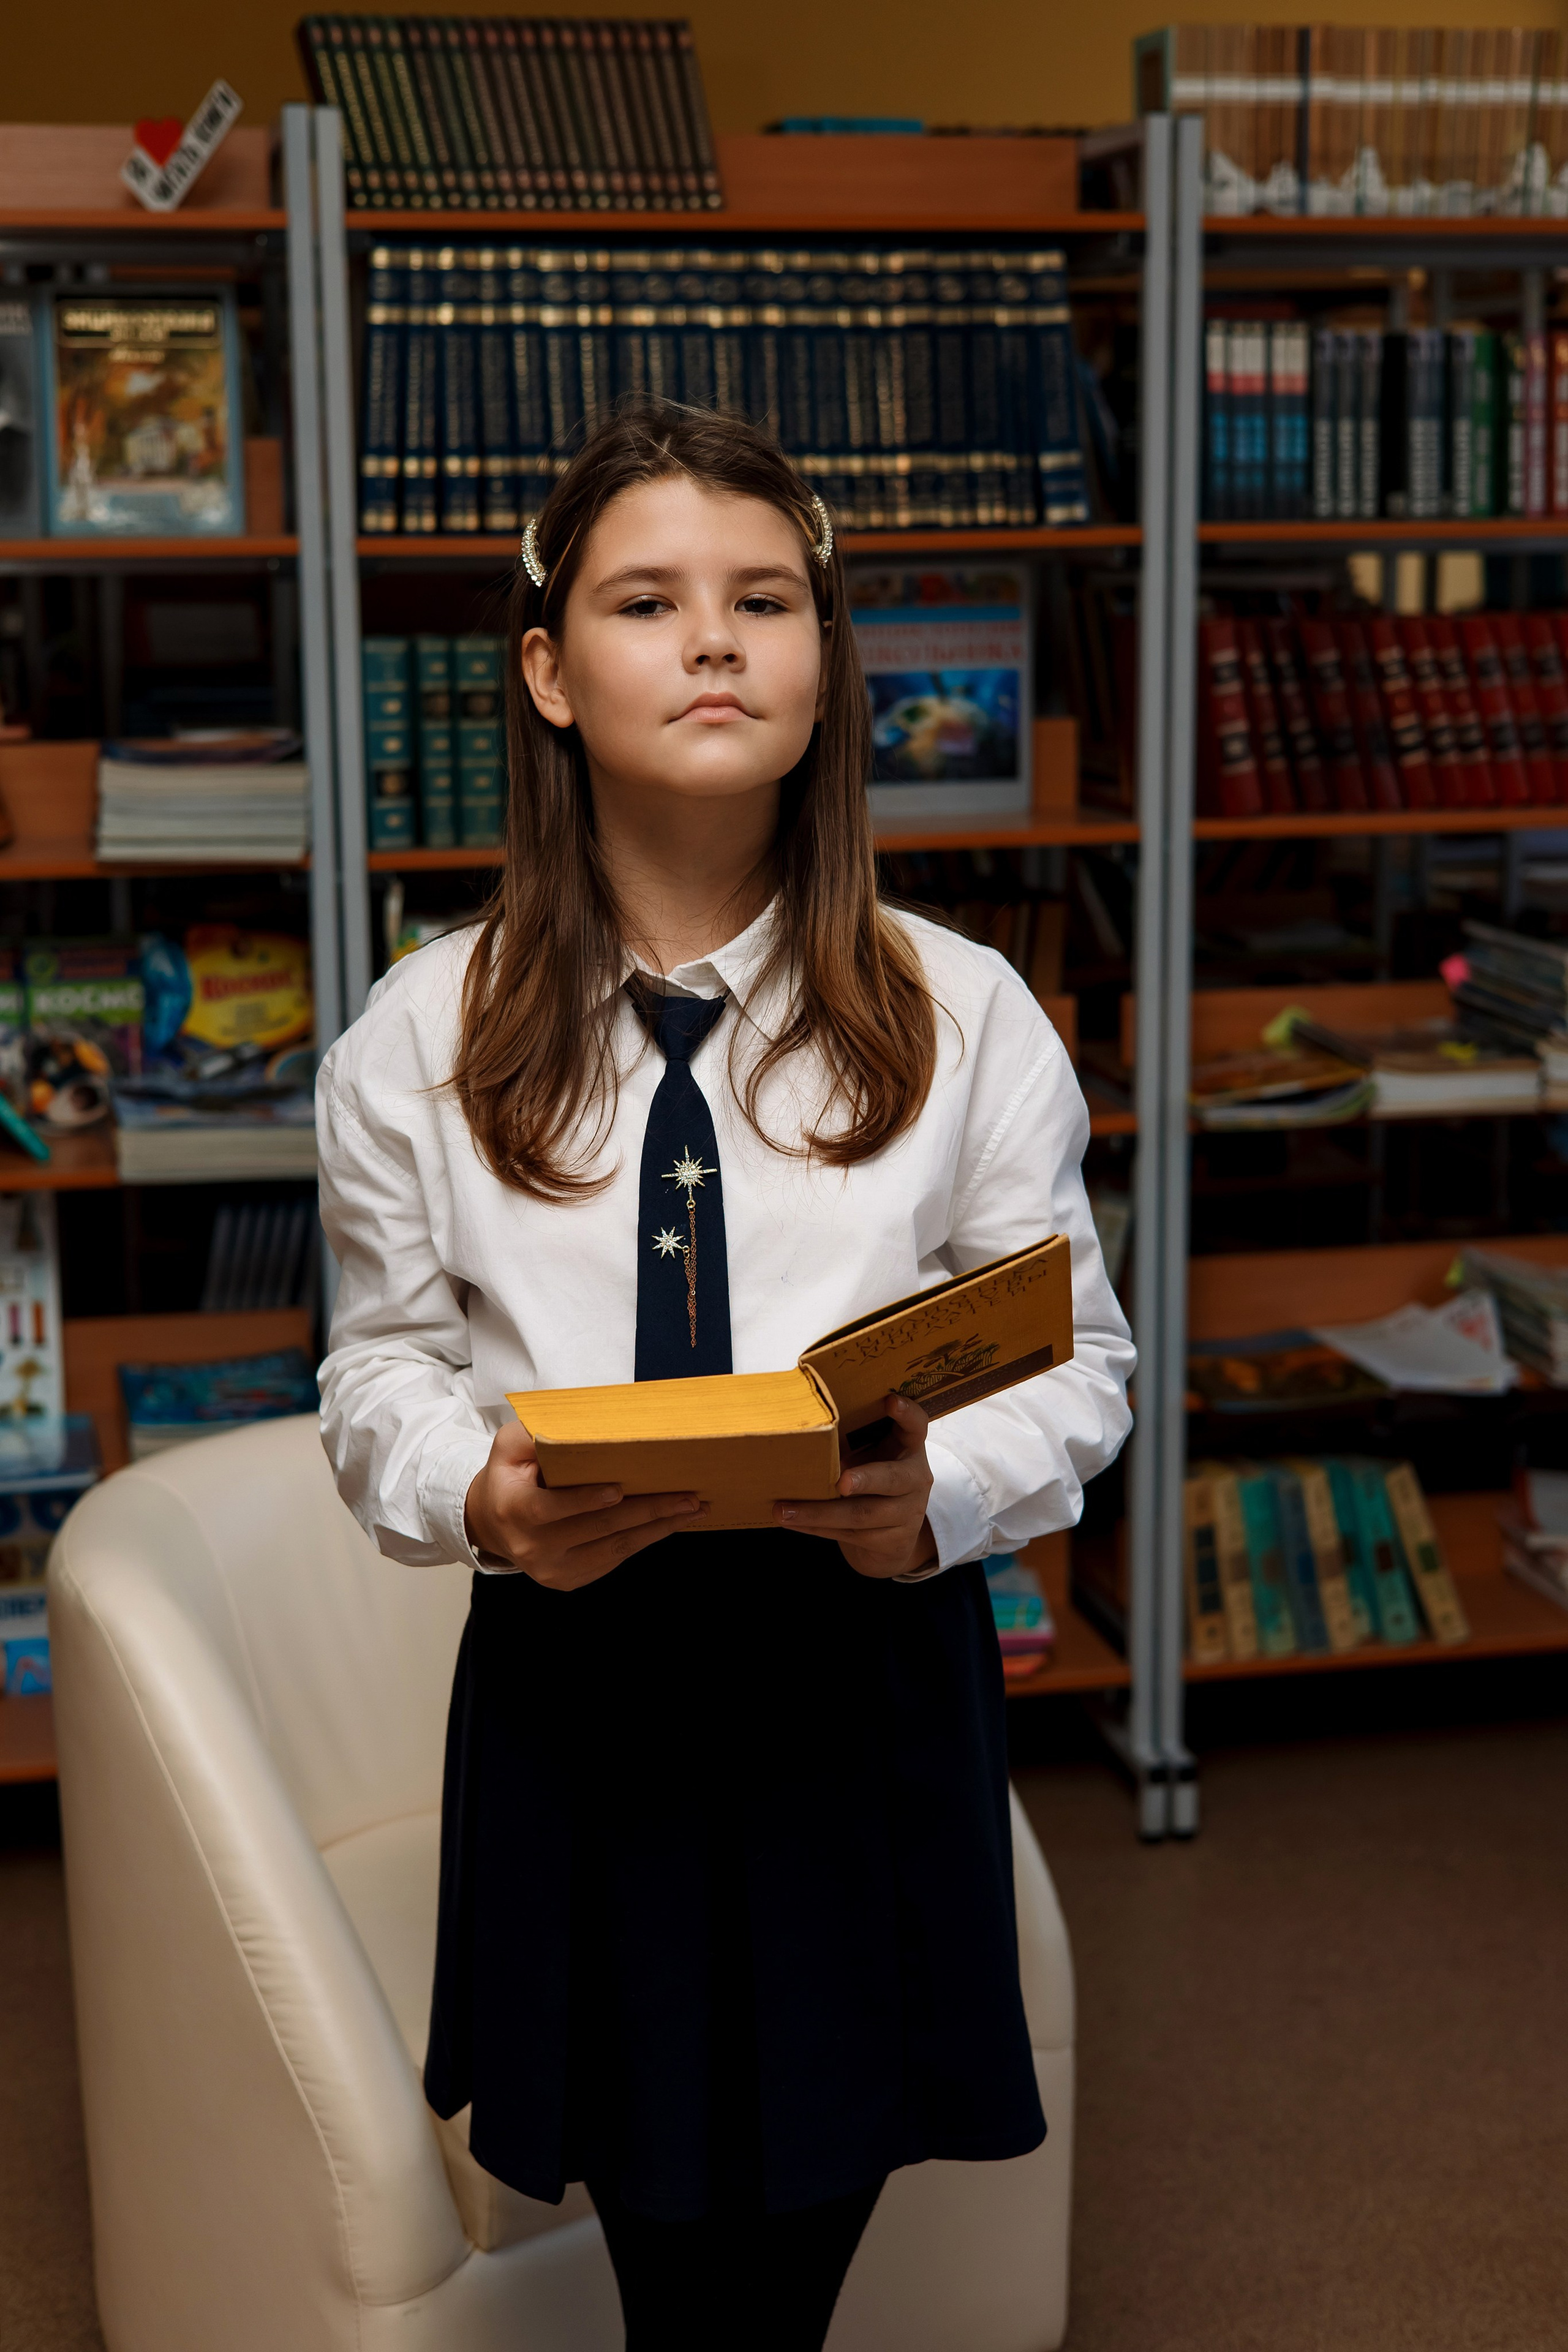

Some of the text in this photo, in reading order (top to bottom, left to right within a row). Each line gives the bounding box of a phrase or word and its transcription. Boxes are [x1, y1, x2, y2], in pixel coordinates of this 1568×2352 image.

[833, 1258, 1047, 1357] БИБЛИОТЕКА
[837, 1270, 1047, 1368] ЛИТЕРАТУРЫ
[859, 1274, 1023, 1352] МИРОВОЙ
[859, 1286, 1027, 1365] ДЛЯ ДЕТЕЙ
